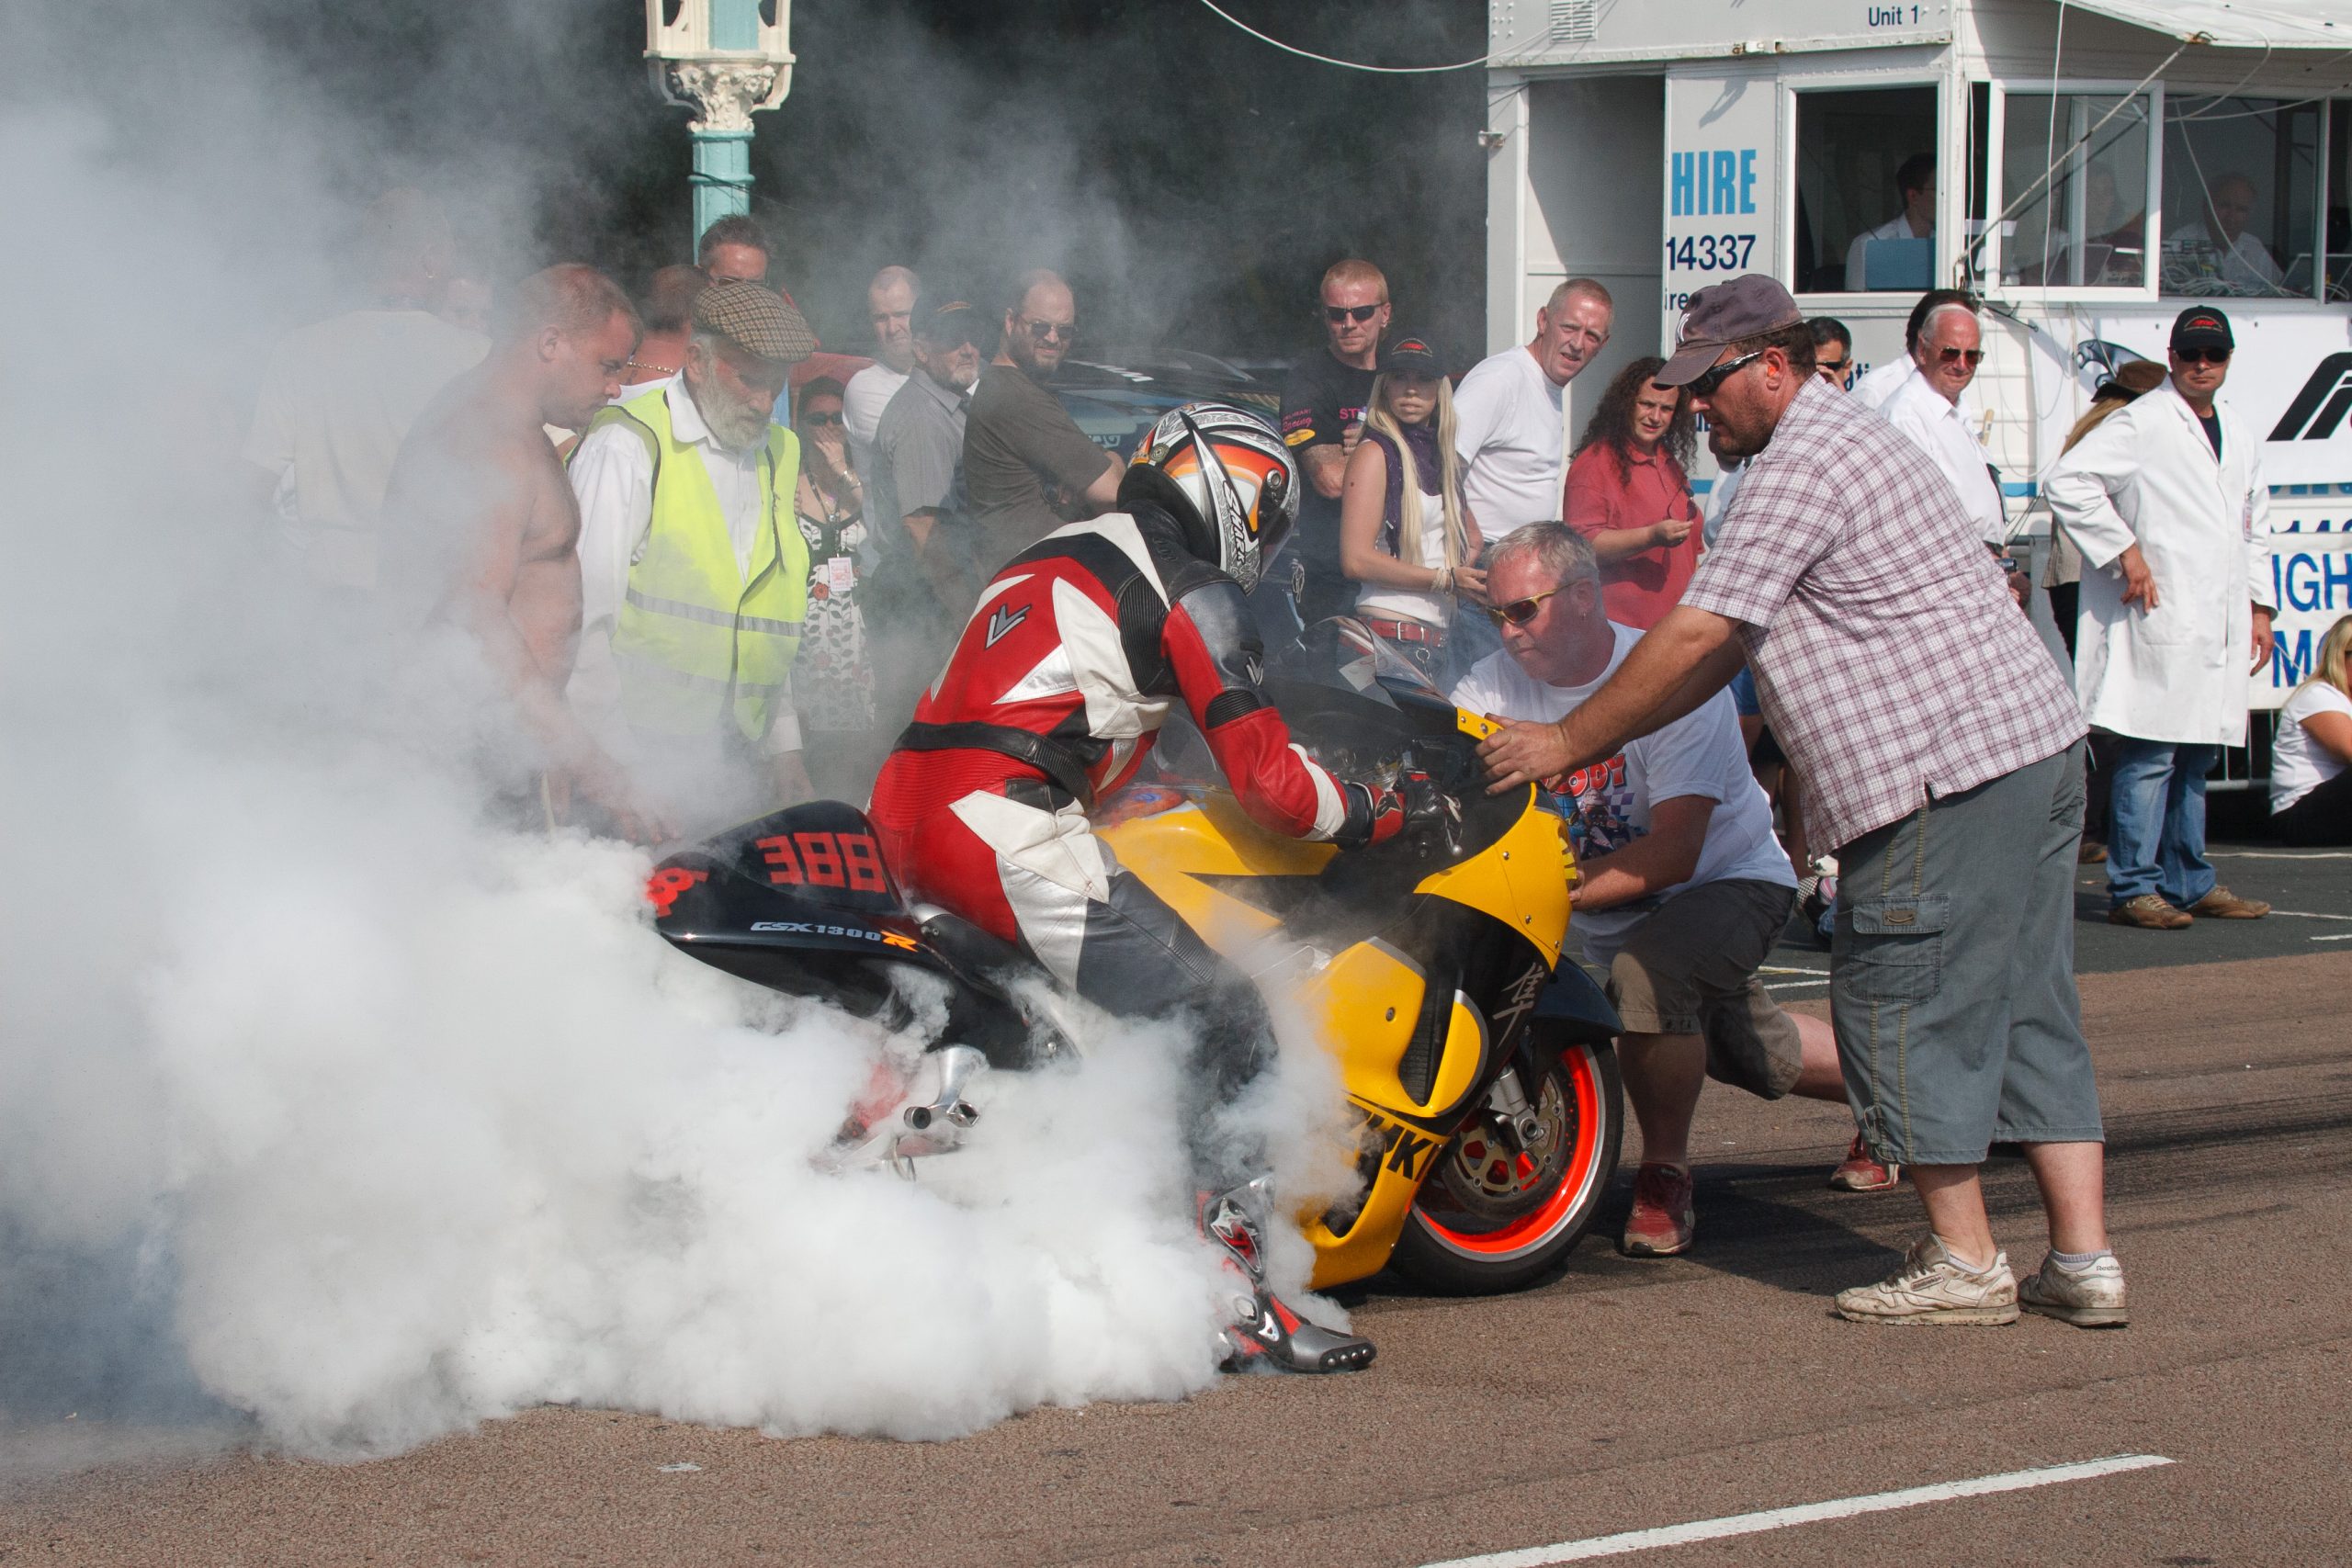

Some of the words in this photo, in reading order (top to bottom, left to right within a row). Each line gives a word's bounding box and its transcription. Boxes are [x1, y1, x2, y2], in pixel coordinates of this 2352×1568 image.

[1869, 6, 1903, 27] Unit
[1910, 5, 1918, 25] 1
[1671, 149, 1757, 217] HIRE
[1666, 233, 1757, 271] 14337
[755, 832, 888, 894] 388
